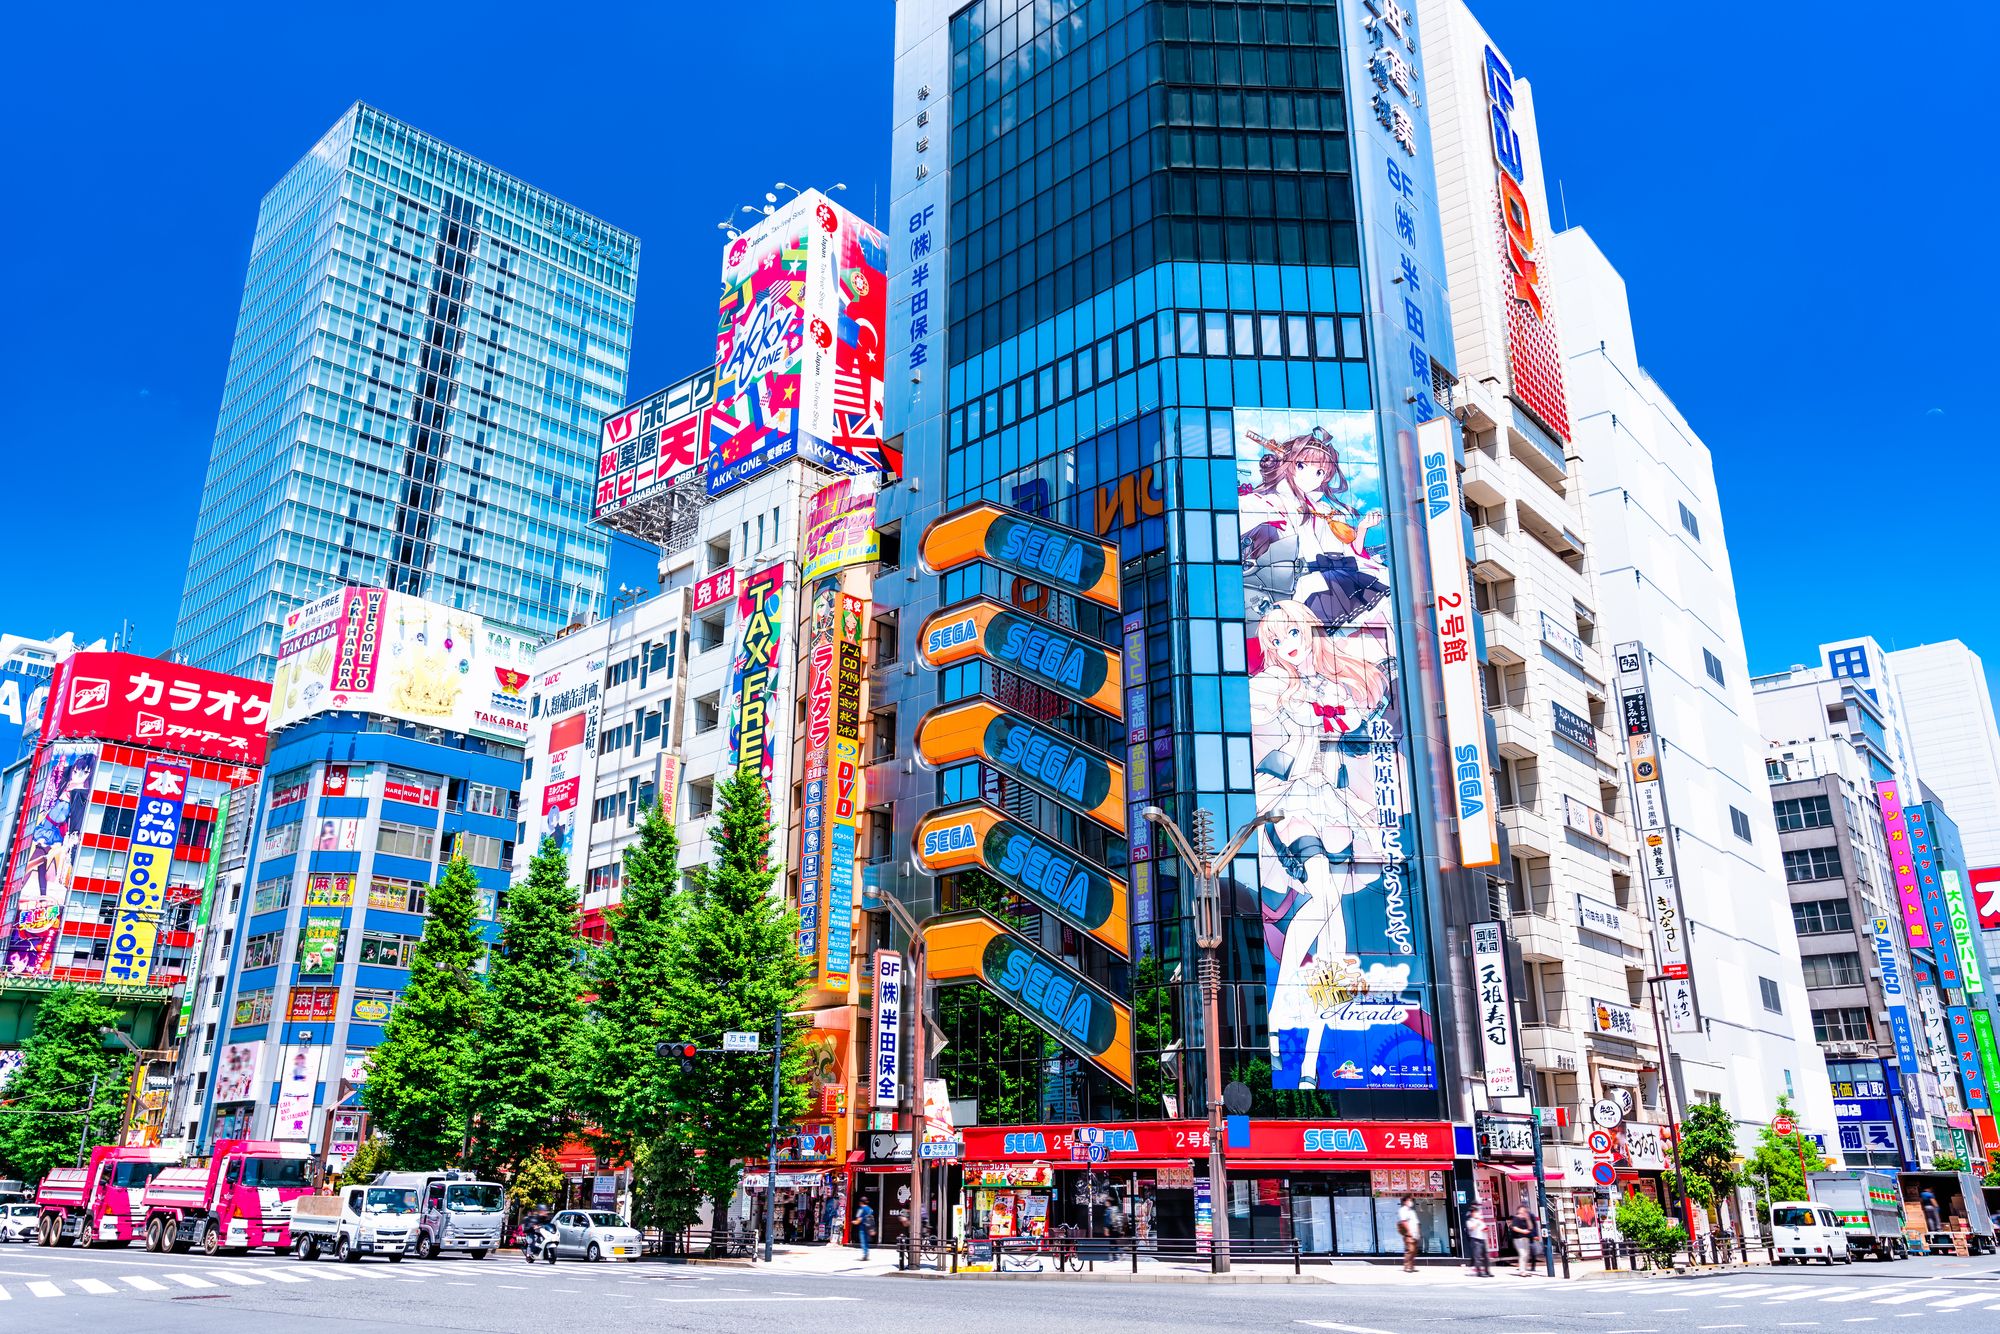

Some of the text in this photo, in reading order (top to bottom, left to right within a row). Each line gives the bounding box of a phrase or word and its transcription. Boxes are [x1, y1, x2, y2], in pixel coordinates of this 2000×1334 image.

[1386, 156, 1413, 200] 8F
[909, 203, 934, 233] 8F
[757, 346, 783, 372] ONE
[600, 432, 658, 477] 秋葉原
[740, 457, 762, 474] ONE
[597, 468, 654, 506] ホビー
[1424, 452, 1448, 519] SEGA
[847, 544, 877, 558] AKIBA
[1001, 525, 1082, 585] SEGA
[697, 571, 731, 607] 免税
[305, 594, 340, 617] TAX-FREE
[282, 622, 337, 656] TAKARADA
[356, 593, 381, 688] WELCOME TO
[743, 578, 773, 671] TAX
[928, 618, 977, 653] SEGA
[1437, 592, 1468, 666] 2号館
[339, 597, 361, 688] AKIHABARA
[488, 632, 537, 652] TAX FRE
[842, 642, 860, 657] ゲーム
[1001, 623, 1085, 690] SEGA
[840, 670, 859, 683] アイドル
[842, 658, 857, 670] CD
[126, 672, 270, 725] カラオケ
[808, 644, 834, 748] ラムタラ
[839, 698, 858, 710] コミック
[840, 683, 859, 696] アニメ
[839, 711, 857, 723] ホビー
[1626, 699, 1640, 726] すみれ
[552, 751, 568, 764] UCC
[1000, 726, 1088, 801] SEGA
[147, 770, 183, 795] 本
[836, 761, 856, 819] DVD
[1454, 744, 1484, 819] SEGA
[139, 813, 176, 831] ゲーム
[148, 800, 173, 816] CD
[137, 828, 173, 845] DVD
[924, 824, 976, 856] SEGA
[1370, 719, 1412, 953] 秋葉原泊地にようこそ。
[314, 877, 348, 891] 麻雀
[1001, 835, 1089, 920] SEGA
[1947, 889, 1983, 988] 大人のデパート
[1875, 937, 1901, 995] ALINCO
[294, 994, 332, 1007] 麻雀
[1001, 950, 1092, 1043] SEGA
[1320, 1002, 1402, 1021] Arcade
[1480, 963, 1508, 1046] 元祖寿司
[878, 961, 899, 1099] 8F (株)半田保全
[1954, 1014, 1982, 1100] カラオケ館
[1004, 1132, 1047, 1154] SEGA
[1090, 1130, 1096, 1139] 17
[1303, 1129, 1428, 1152] SEGA 2号館
[1984, 1141, 1999, 1150] au
[1090, 1148, 1099, 1157] 17
